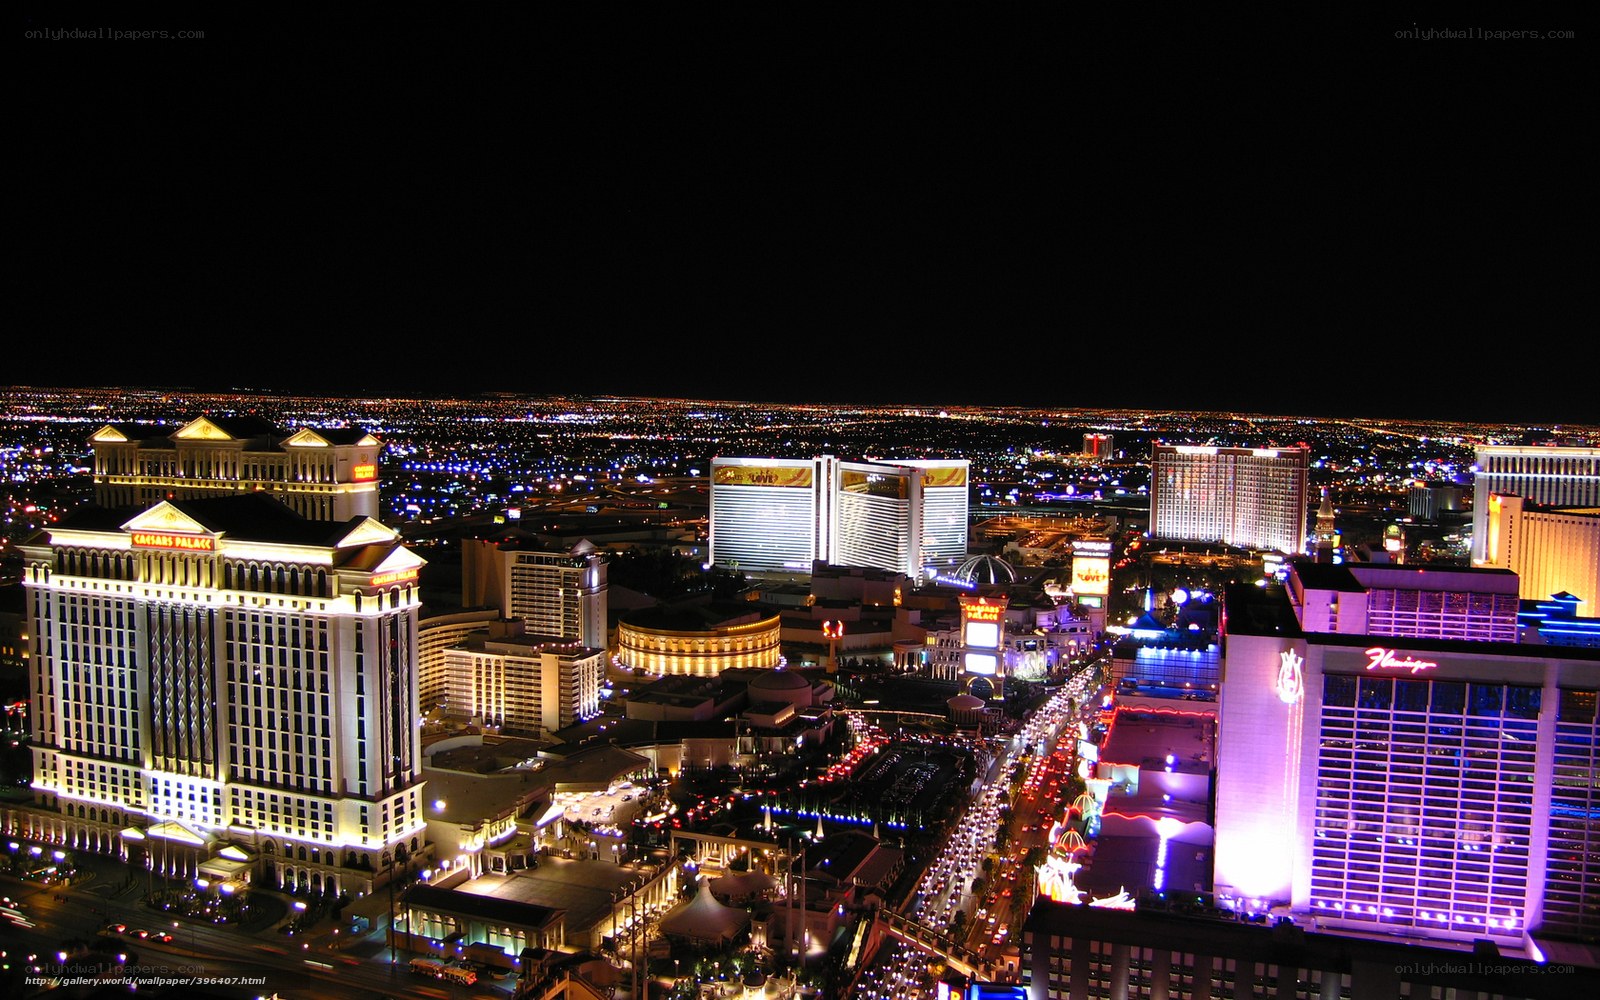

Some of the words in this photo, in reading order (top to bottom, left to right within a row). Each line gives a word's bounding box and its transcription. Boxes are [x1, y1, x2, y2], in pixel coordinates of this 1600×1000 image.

[134, 534, 173, 547] CAESARS
[175, 537, 211, 549] PALACE
[966, 604, 1000, 614] CAESARS
[967, 612, 998, 621] PALACE
[1365, 647, 1437, 674] Flamingo
